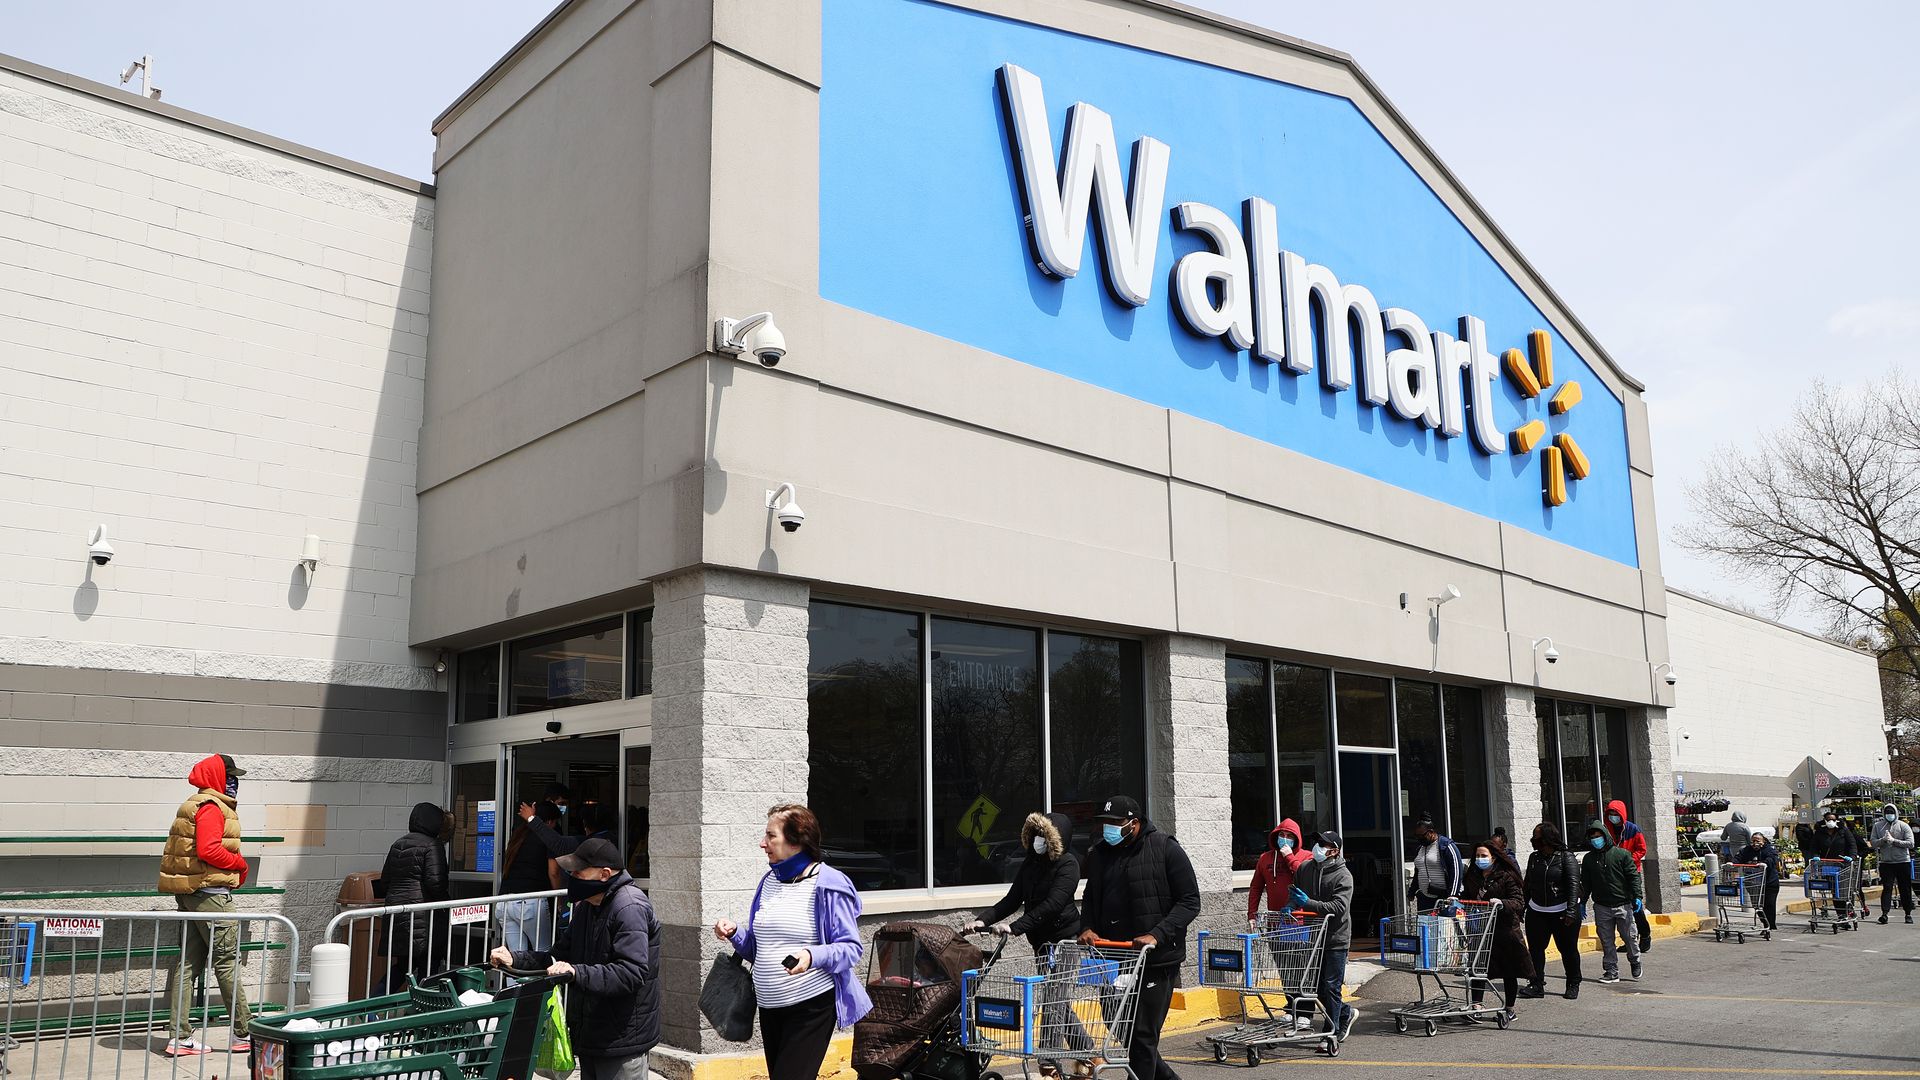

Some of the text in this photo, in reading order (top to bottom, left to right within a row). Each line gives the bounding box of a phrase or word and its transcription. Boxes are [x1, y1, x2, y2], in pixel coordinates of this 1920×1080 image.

[994, 62, 1506, 456] Walmart
[949, 660, 1021, 692] ENTRANCE
[452, 905, 488, 917] NATIONAL
[47, 918, 101, 929] NATIONAL
[983, 1009, 1003, 1017] Walmart
